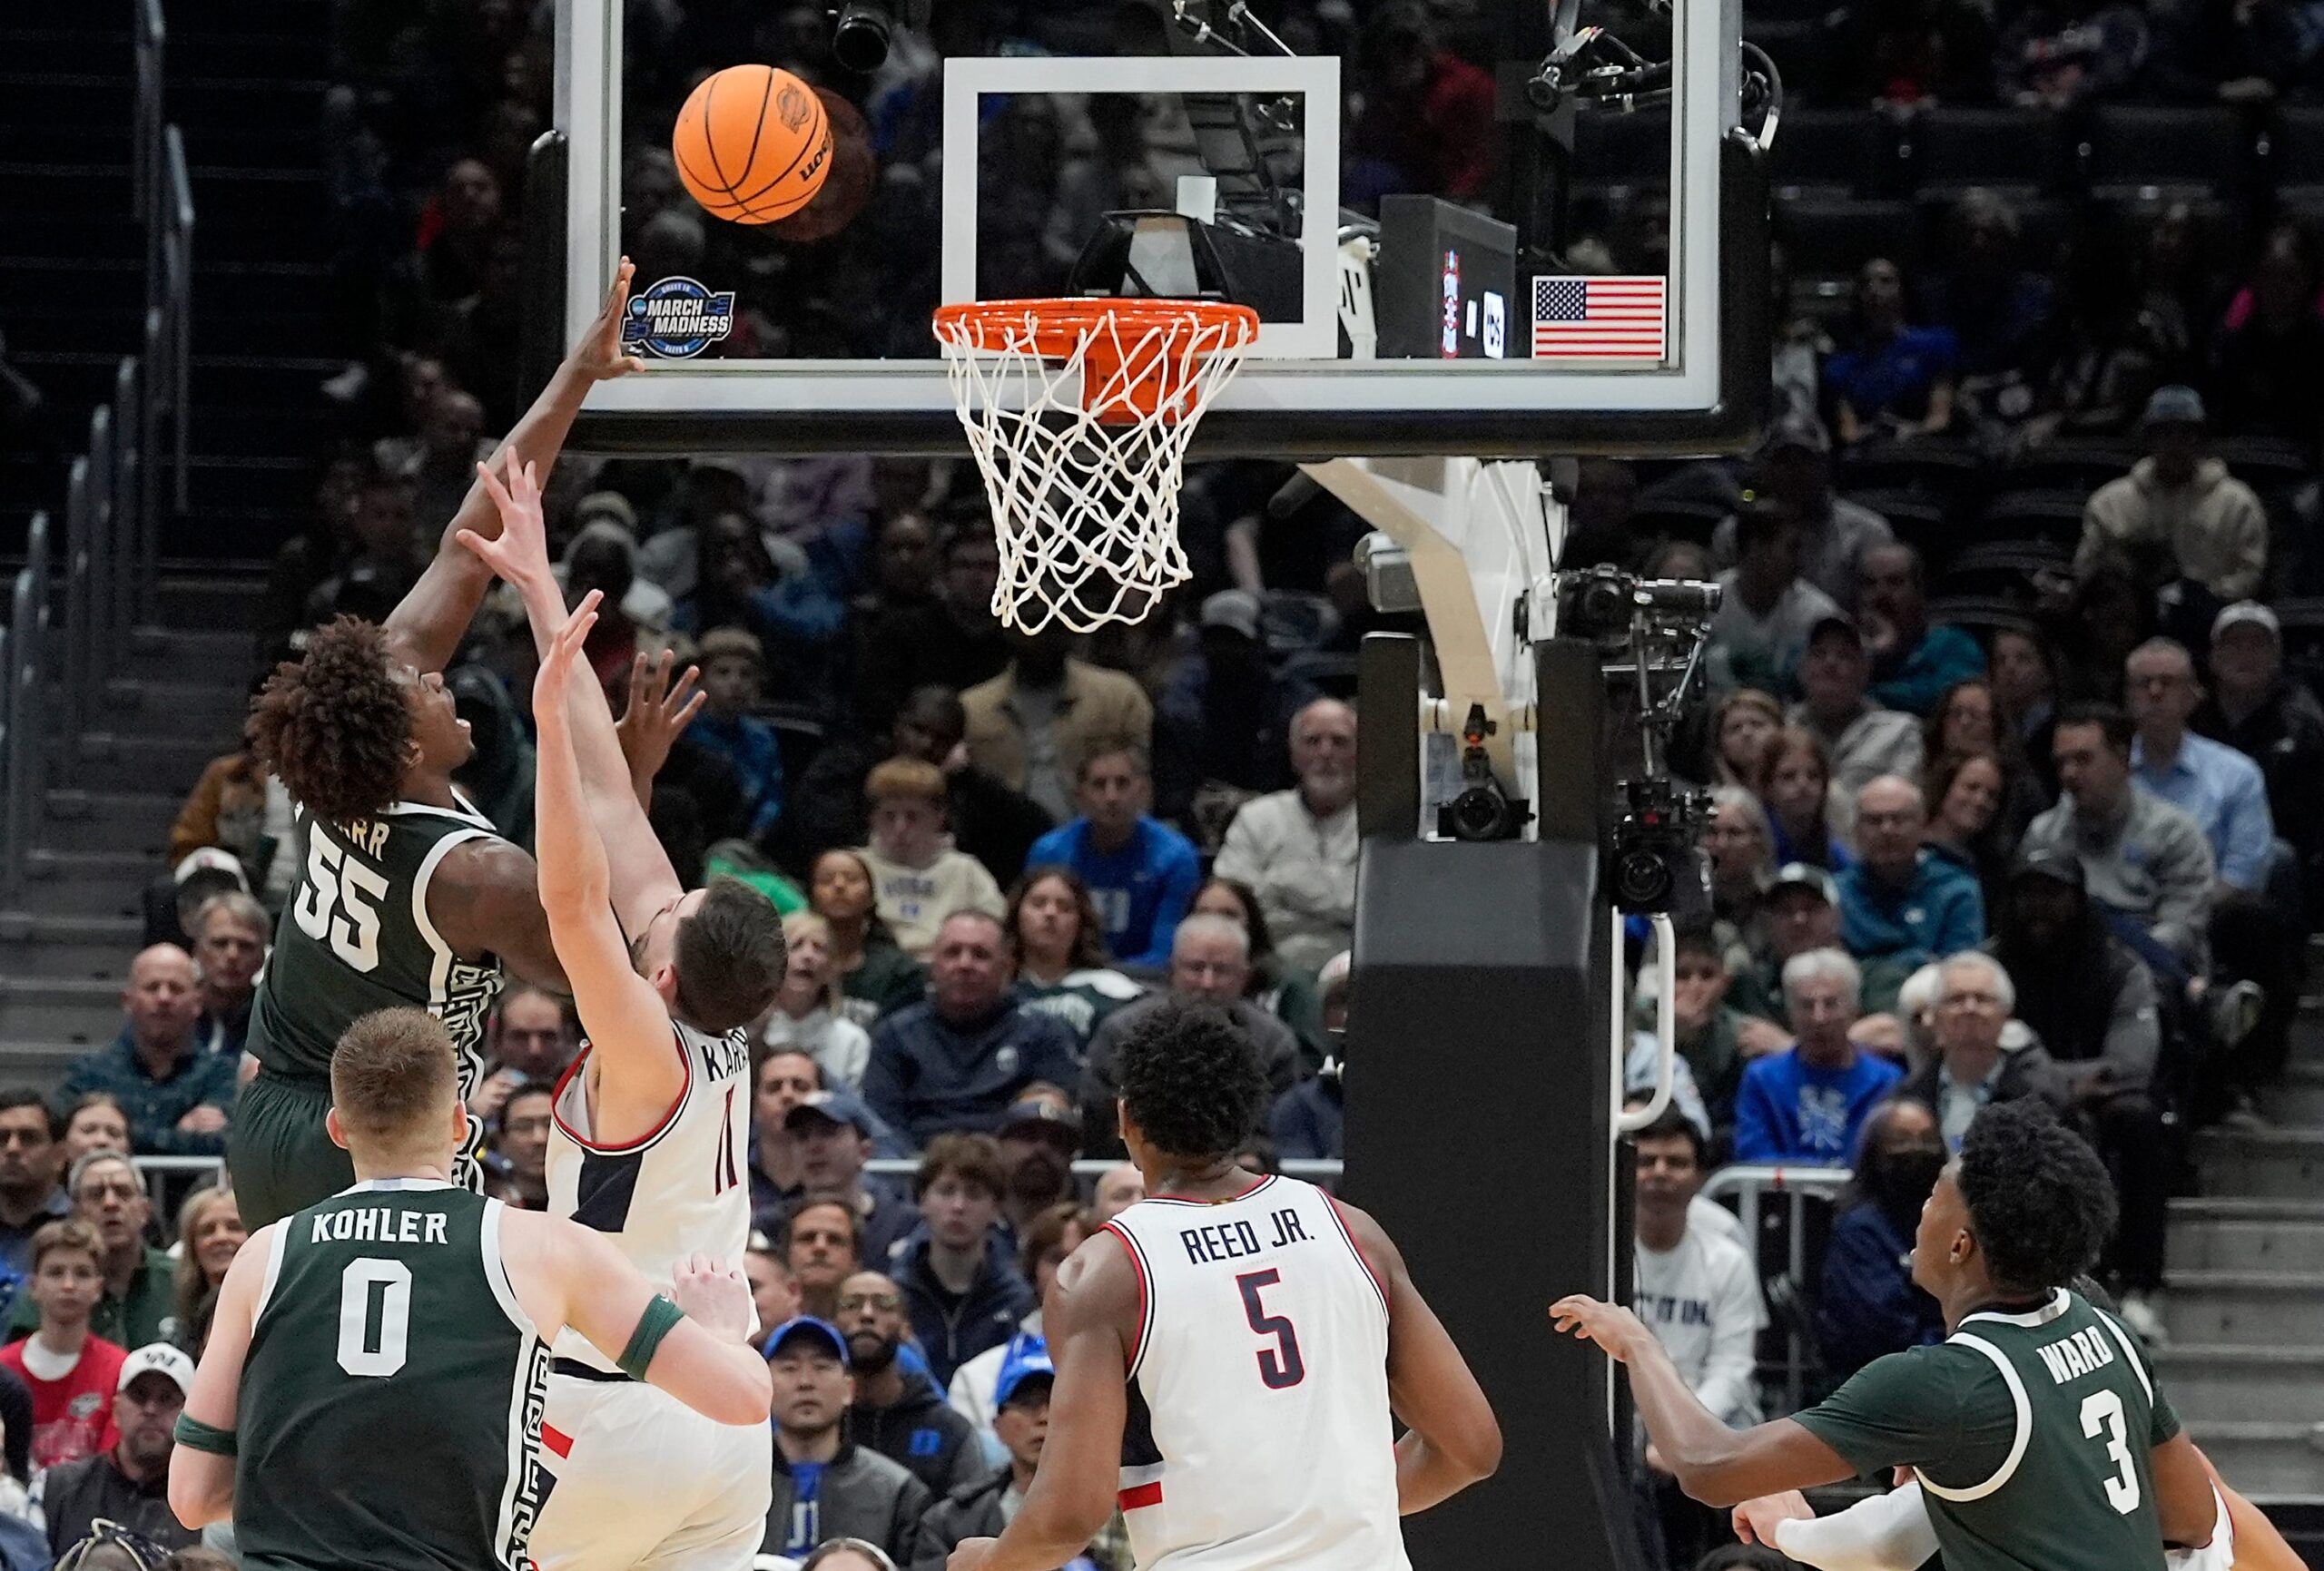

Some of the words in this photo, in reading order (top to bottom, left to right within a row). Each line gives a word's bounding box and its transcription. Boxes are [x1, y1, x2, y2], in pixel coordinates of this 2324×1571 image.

[647, 299, 704, 317] MARCH
[654, 316, 729, 333] MADNESS
[294, 820, 389, 974] 55
[714, 1083, 738, 1205] 11
[311, 1208, 448, 1244] KOHLER
[1179, 1221, 1261, 1265] REED
[1271, 1208, 1315, 1248] JR.
[337, 1257, 412, 1377] 0
[1236, 1268, 1305, 1389] 5
[2035, 1325, 2114, 1385] WARD
[2079, 1389, 2141, 1516] 3
